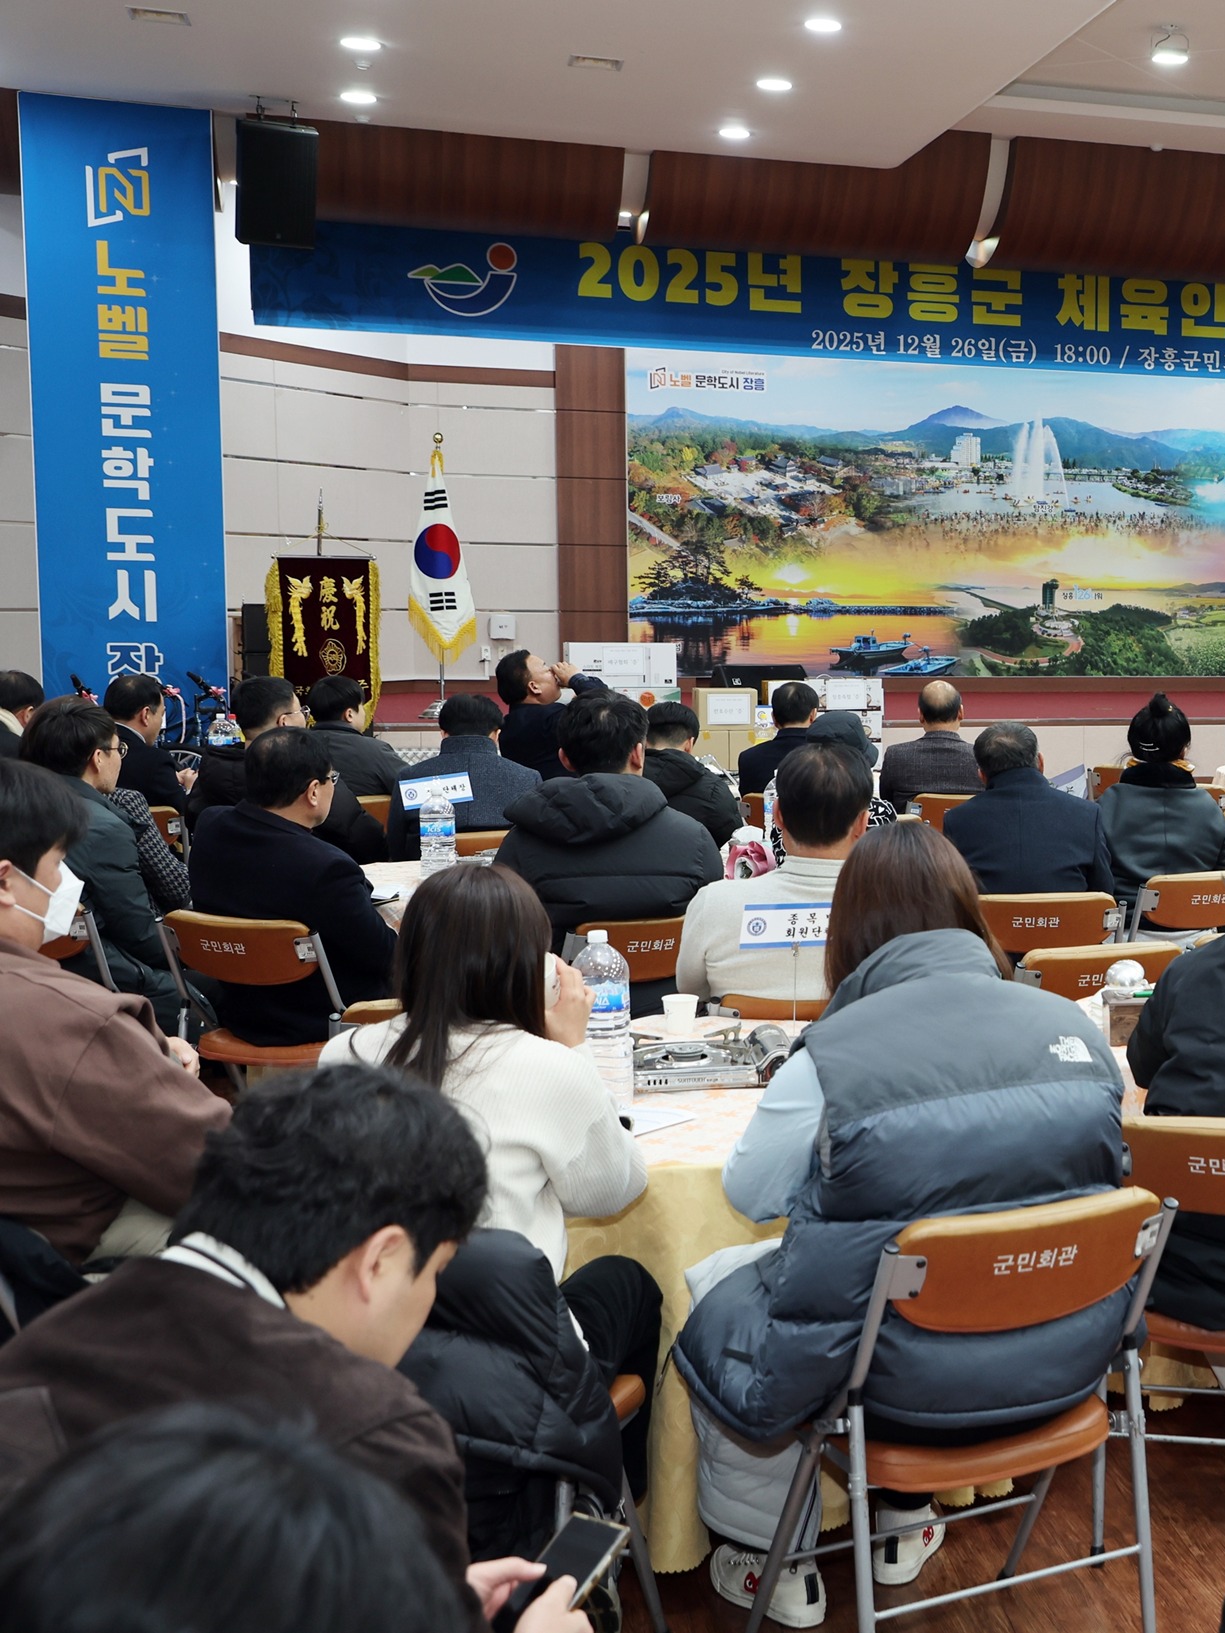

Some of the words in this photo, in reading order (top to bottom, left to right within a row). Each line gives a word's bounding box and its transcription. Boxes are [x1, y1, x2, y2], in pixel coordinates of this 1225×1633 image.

[577, 242, 802, 314] 2025년
[840, 257, 1023, 327] 장흥군
[96, 239, 150, 361] 노벨
[811, 330, 887, 356] 2025년
[896, 334, 942, 359] 12월
[951, 338, 1038, 364] 26일(금)
[1054, 344, 1111, 366] 18:00
[669, 374, 692, 388] 노벨
[695, 374, 740, 390] 문학도시
[743, 377, 765, 391] 장흥
[100, 382, 158, 623] 문학도시
[656, 494, 681, 504] 보림사
[1033, 504, 1054, 513] 탐진강
[319, 576, 340, 631] 慶祝
[1011, 915, 1061, 929] 군민회관
[200, 938, 247, 956] 군민회관
[627, 937, 676, 953] 군민회관
[993, 1245, 1079, 1276] 군민회관
